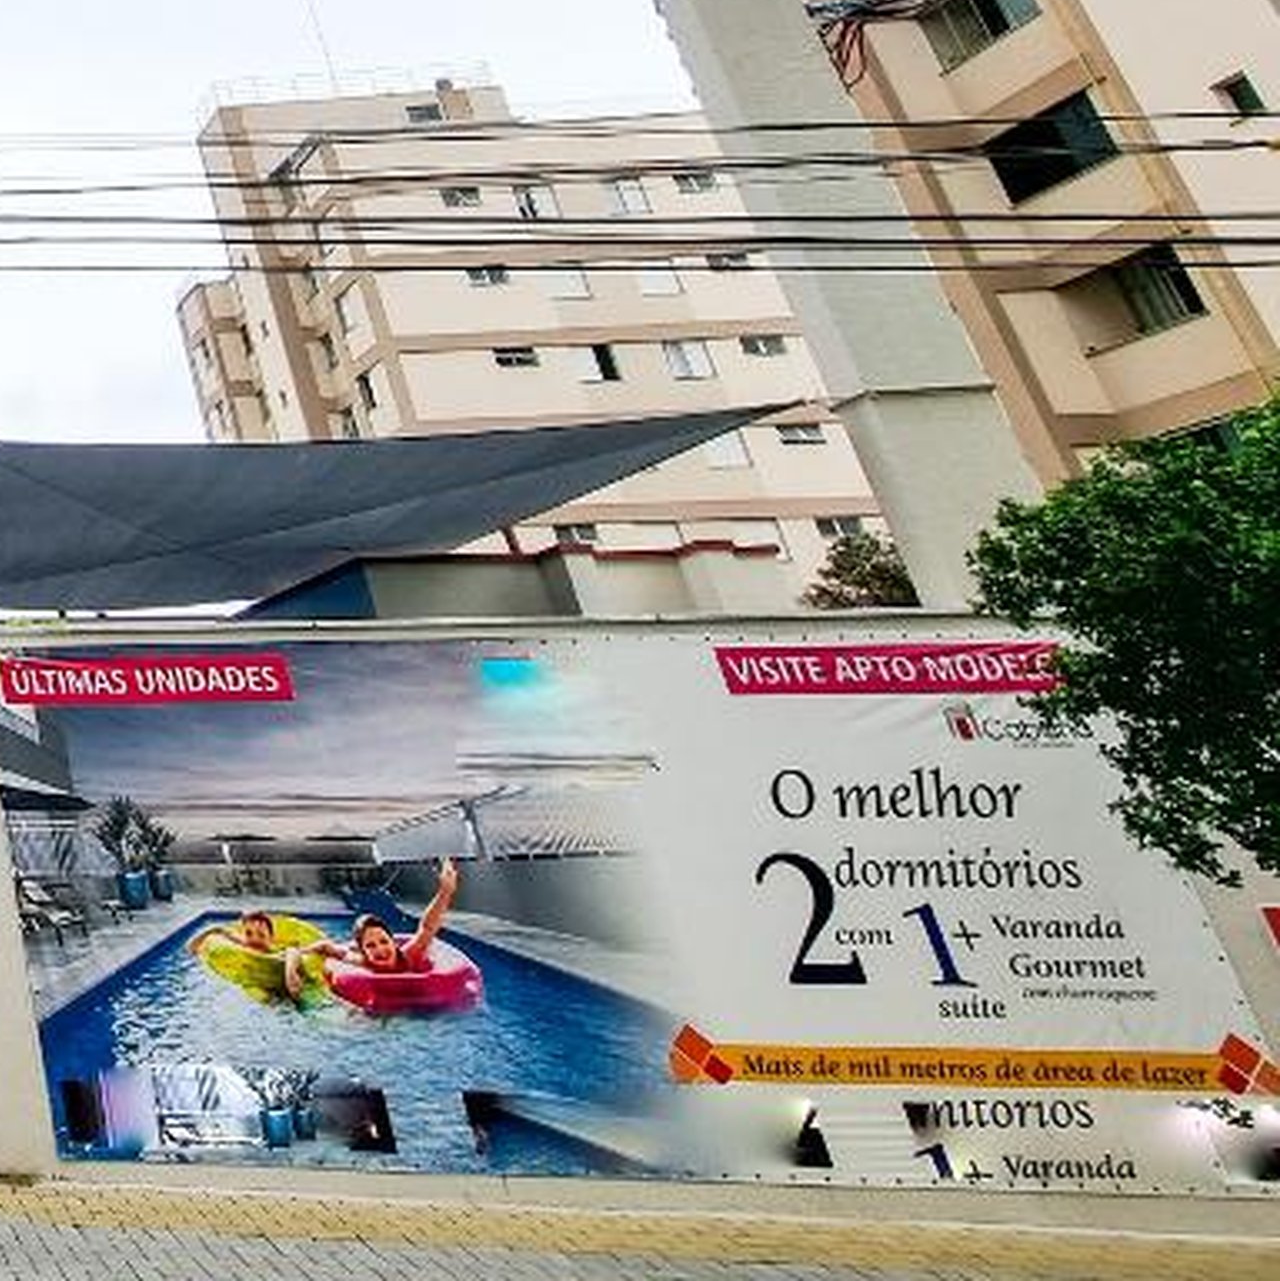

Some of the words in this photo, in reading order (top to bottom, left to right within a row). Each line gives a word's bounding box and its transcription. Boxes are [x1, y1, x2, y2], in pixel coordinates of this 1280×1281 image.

[11, 661, 127, 695] ÚLTIMAS
[135, 665, 279, 694] UNIDADES
[726, 656, 828, 685] VISITE
[834, 656, 917, 683] APTO
[771, 769, 815, 819] O
[834, 767, 1022, 819] melhor
[755, 852, 867, 984] 2
[835, 846, 1083, 888] dormitórios
[835, 926, 894, 946] com
[902, 903, 979, 988] 1
[990, 913, 1126, 940] Varanda
[1009, 953, 1146, 980] Gourmet
[742, 1053, 804, 1076] Mais
[811, 1054, 841, 1076] de
[849, 1055, 891, 1078] mil
[899, 1058, 987, 1080] metros
[995, 1058, 1025, 1081] de
[1100, 1060, 1131, 1083] de
[1140, 1060, 1208, 1086] lazer
[1003, 1154, 1137, 1179] Varanda
